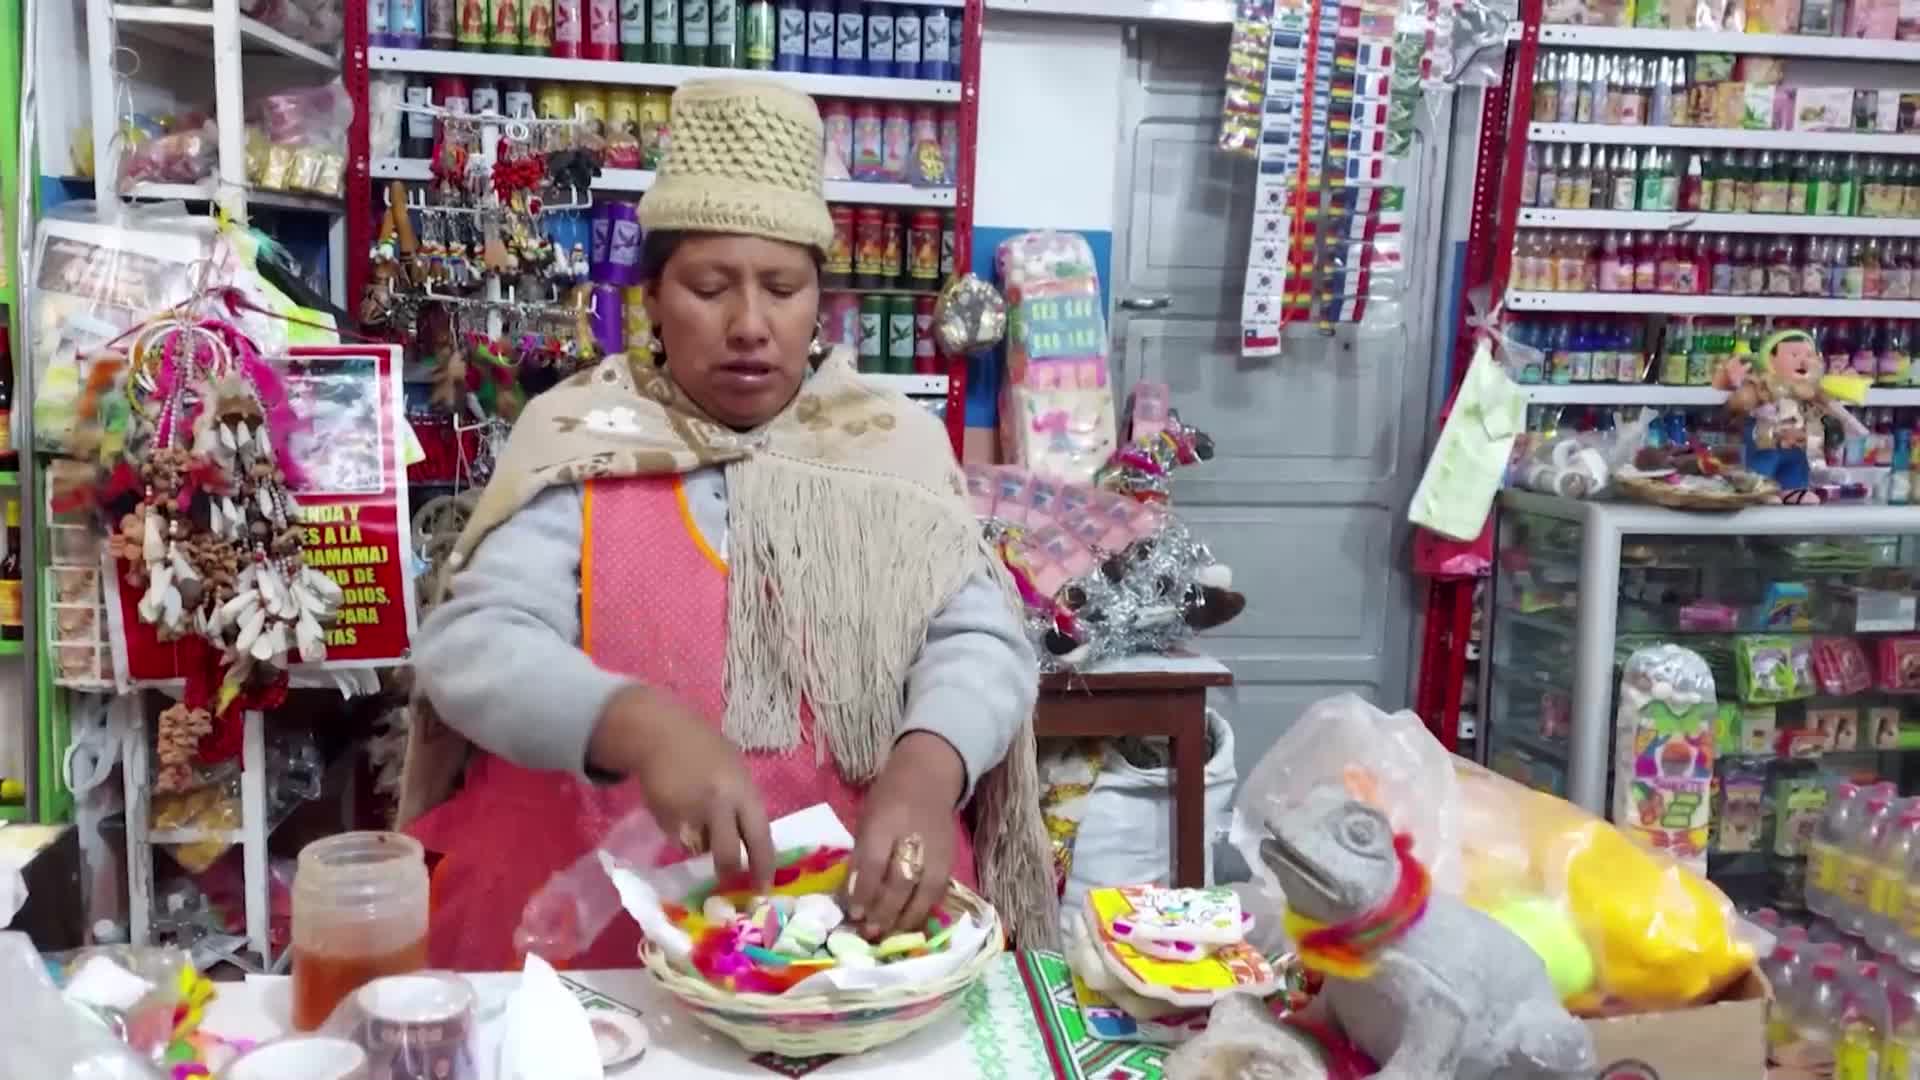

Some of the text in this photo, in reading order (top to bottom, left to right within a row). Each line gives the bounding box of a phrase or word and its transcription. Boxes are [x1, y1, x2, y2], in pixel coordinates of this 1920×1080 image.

[349, 504, 360, 521] Y
[325, 527, 337, 544] A
[340, 525, 362, 544] LA
[353, 567, 377, 584] DE
[344, 587, 390, 605] DIOS,
[336, 606, 379, 624] PARA
